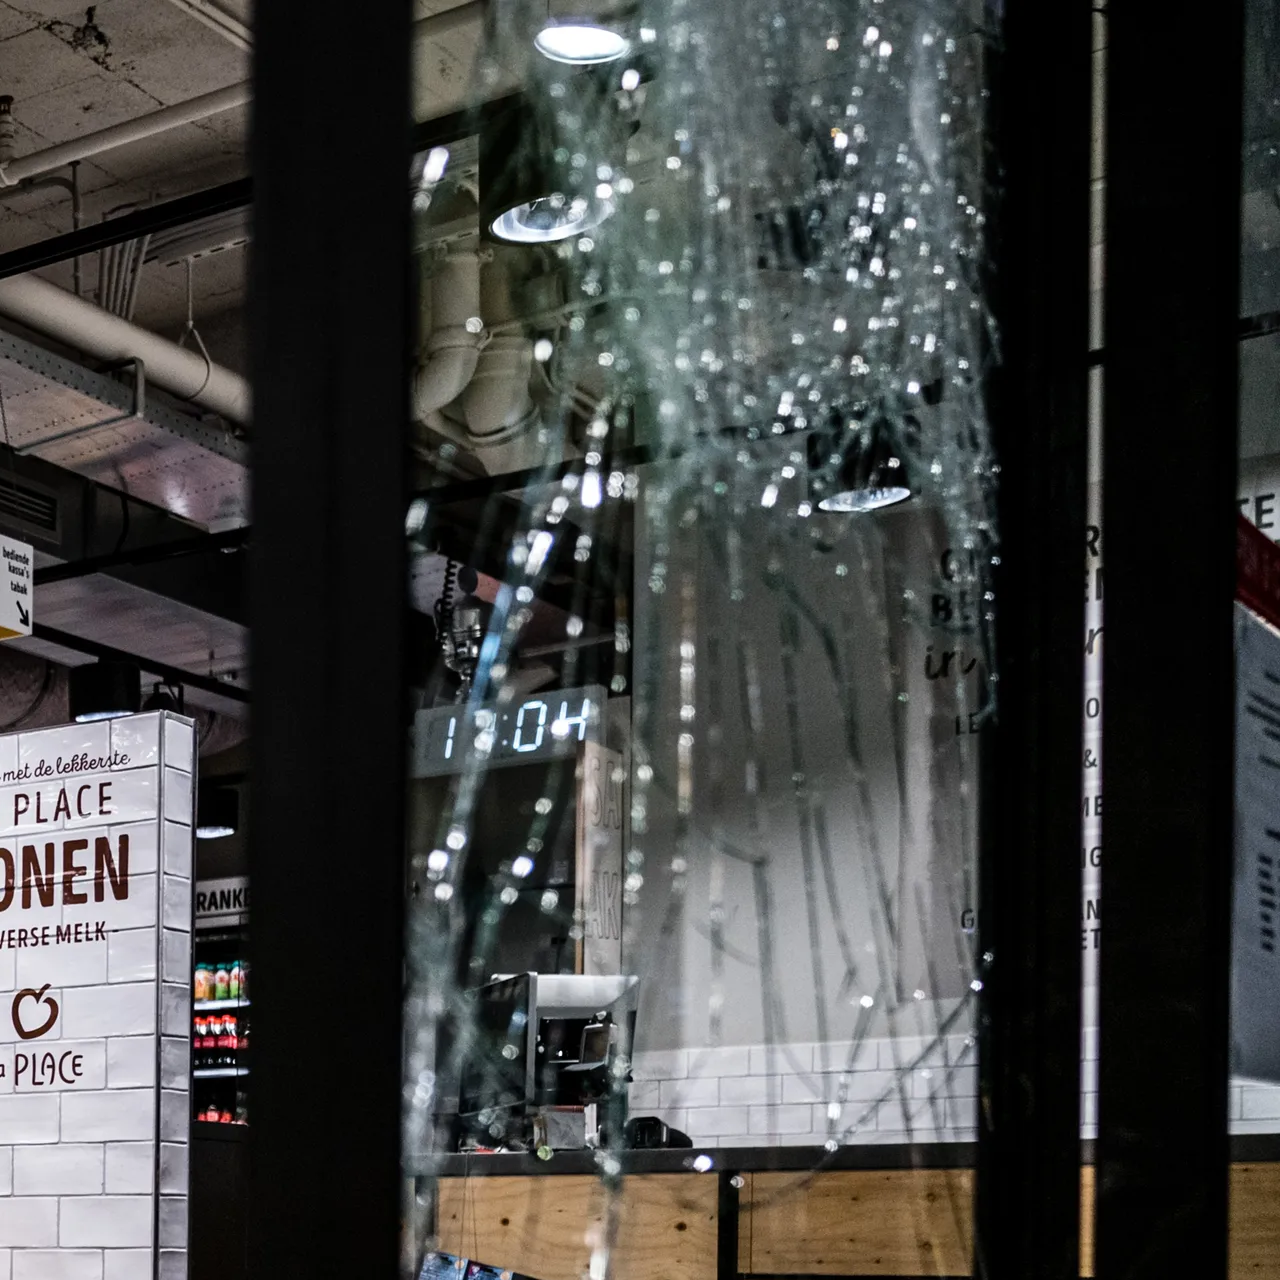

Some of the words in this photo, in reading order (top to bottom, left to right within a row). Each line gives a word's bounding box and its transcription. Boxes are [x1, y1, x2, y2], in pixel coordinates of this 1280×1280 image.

[2, 546, 30, 566] bediende
[8, 561, 30, 579] kassa's
[10, 581, 28, 595] tabak
[2, 761, 32, 783] met
[34, 759, 54, 778] de
[55, 750, 131, 776] lekkerste
[14, 782, 113, 826] PLACE
[55, 921, 107, 944] MELK
[15, 1050, 84, 1087] PLACE
